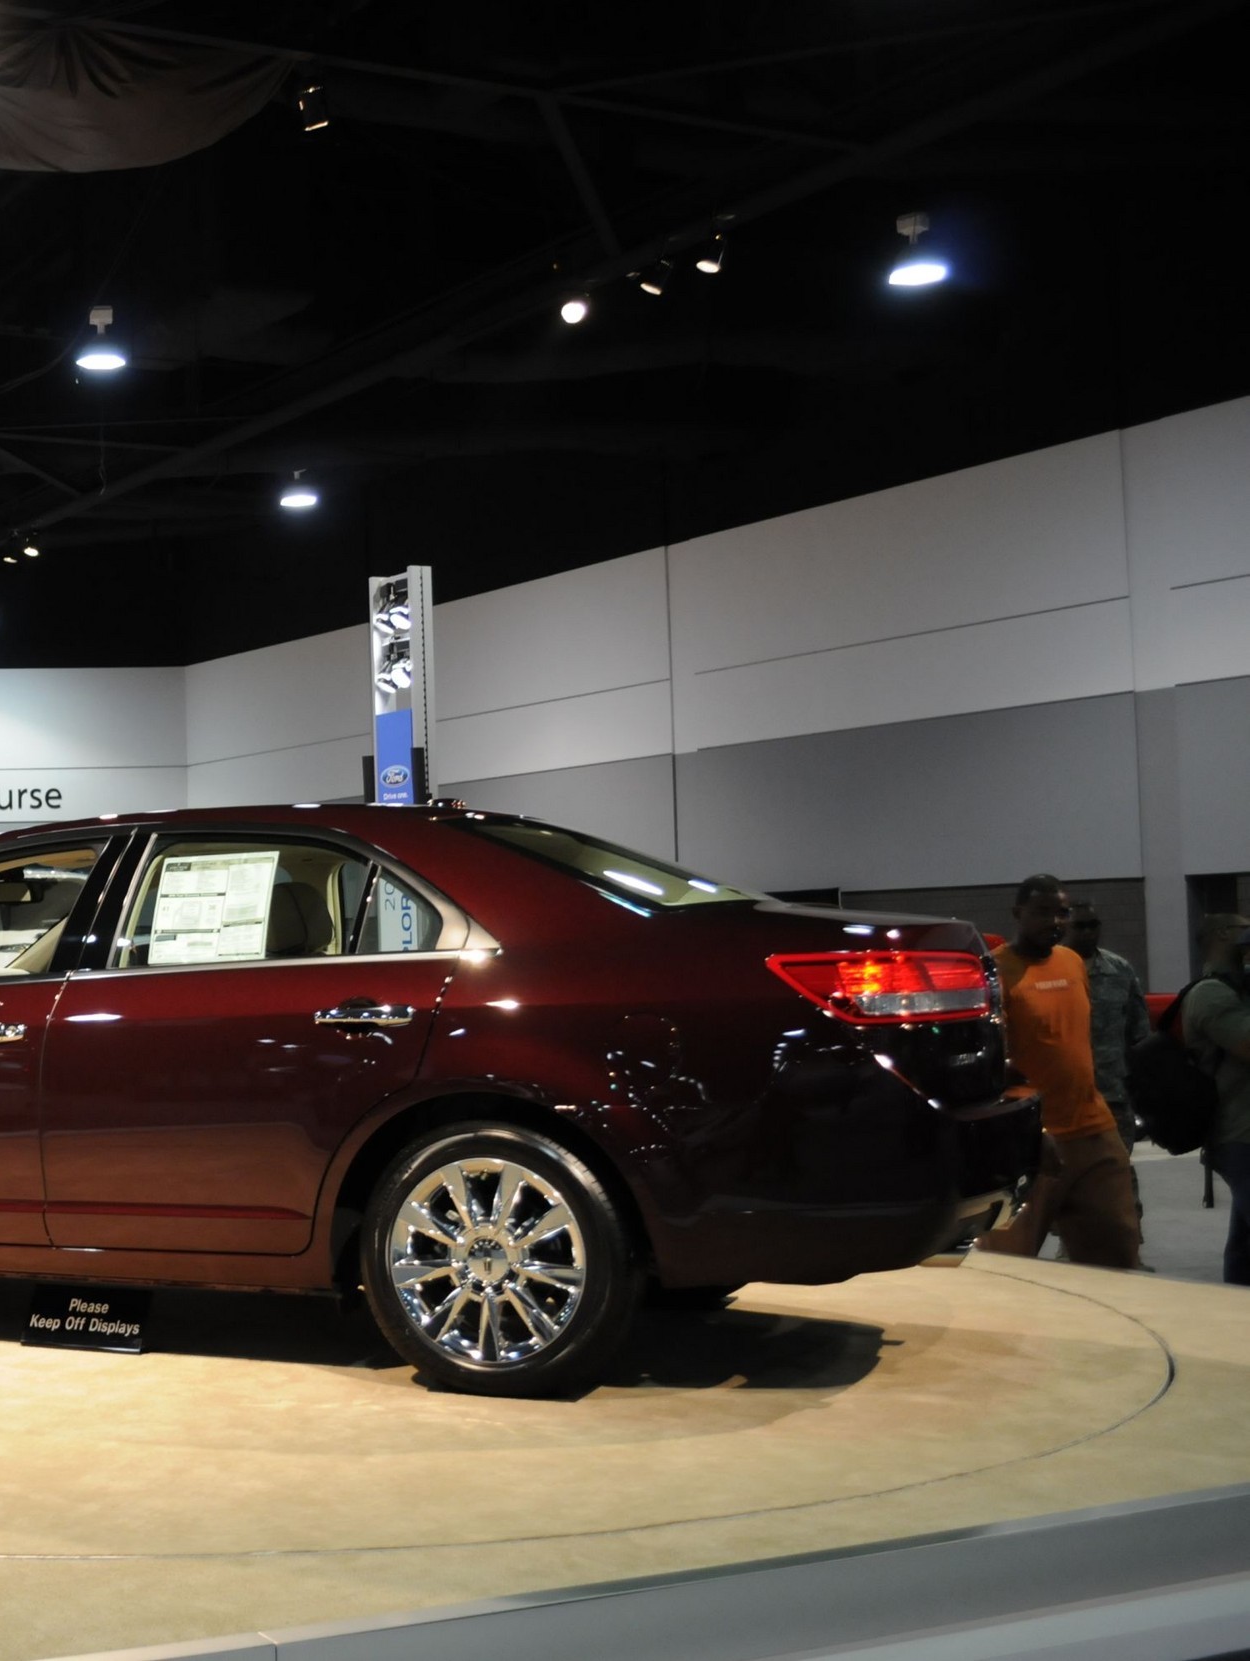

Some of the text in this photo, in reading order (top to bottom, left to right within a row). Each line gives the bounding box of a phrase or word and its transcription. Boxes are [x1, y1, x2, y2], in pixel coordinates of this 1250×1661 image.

[68, 1298, 110, 1314] Please
[29, 1313, 141, 1337] Keep Off Displays
